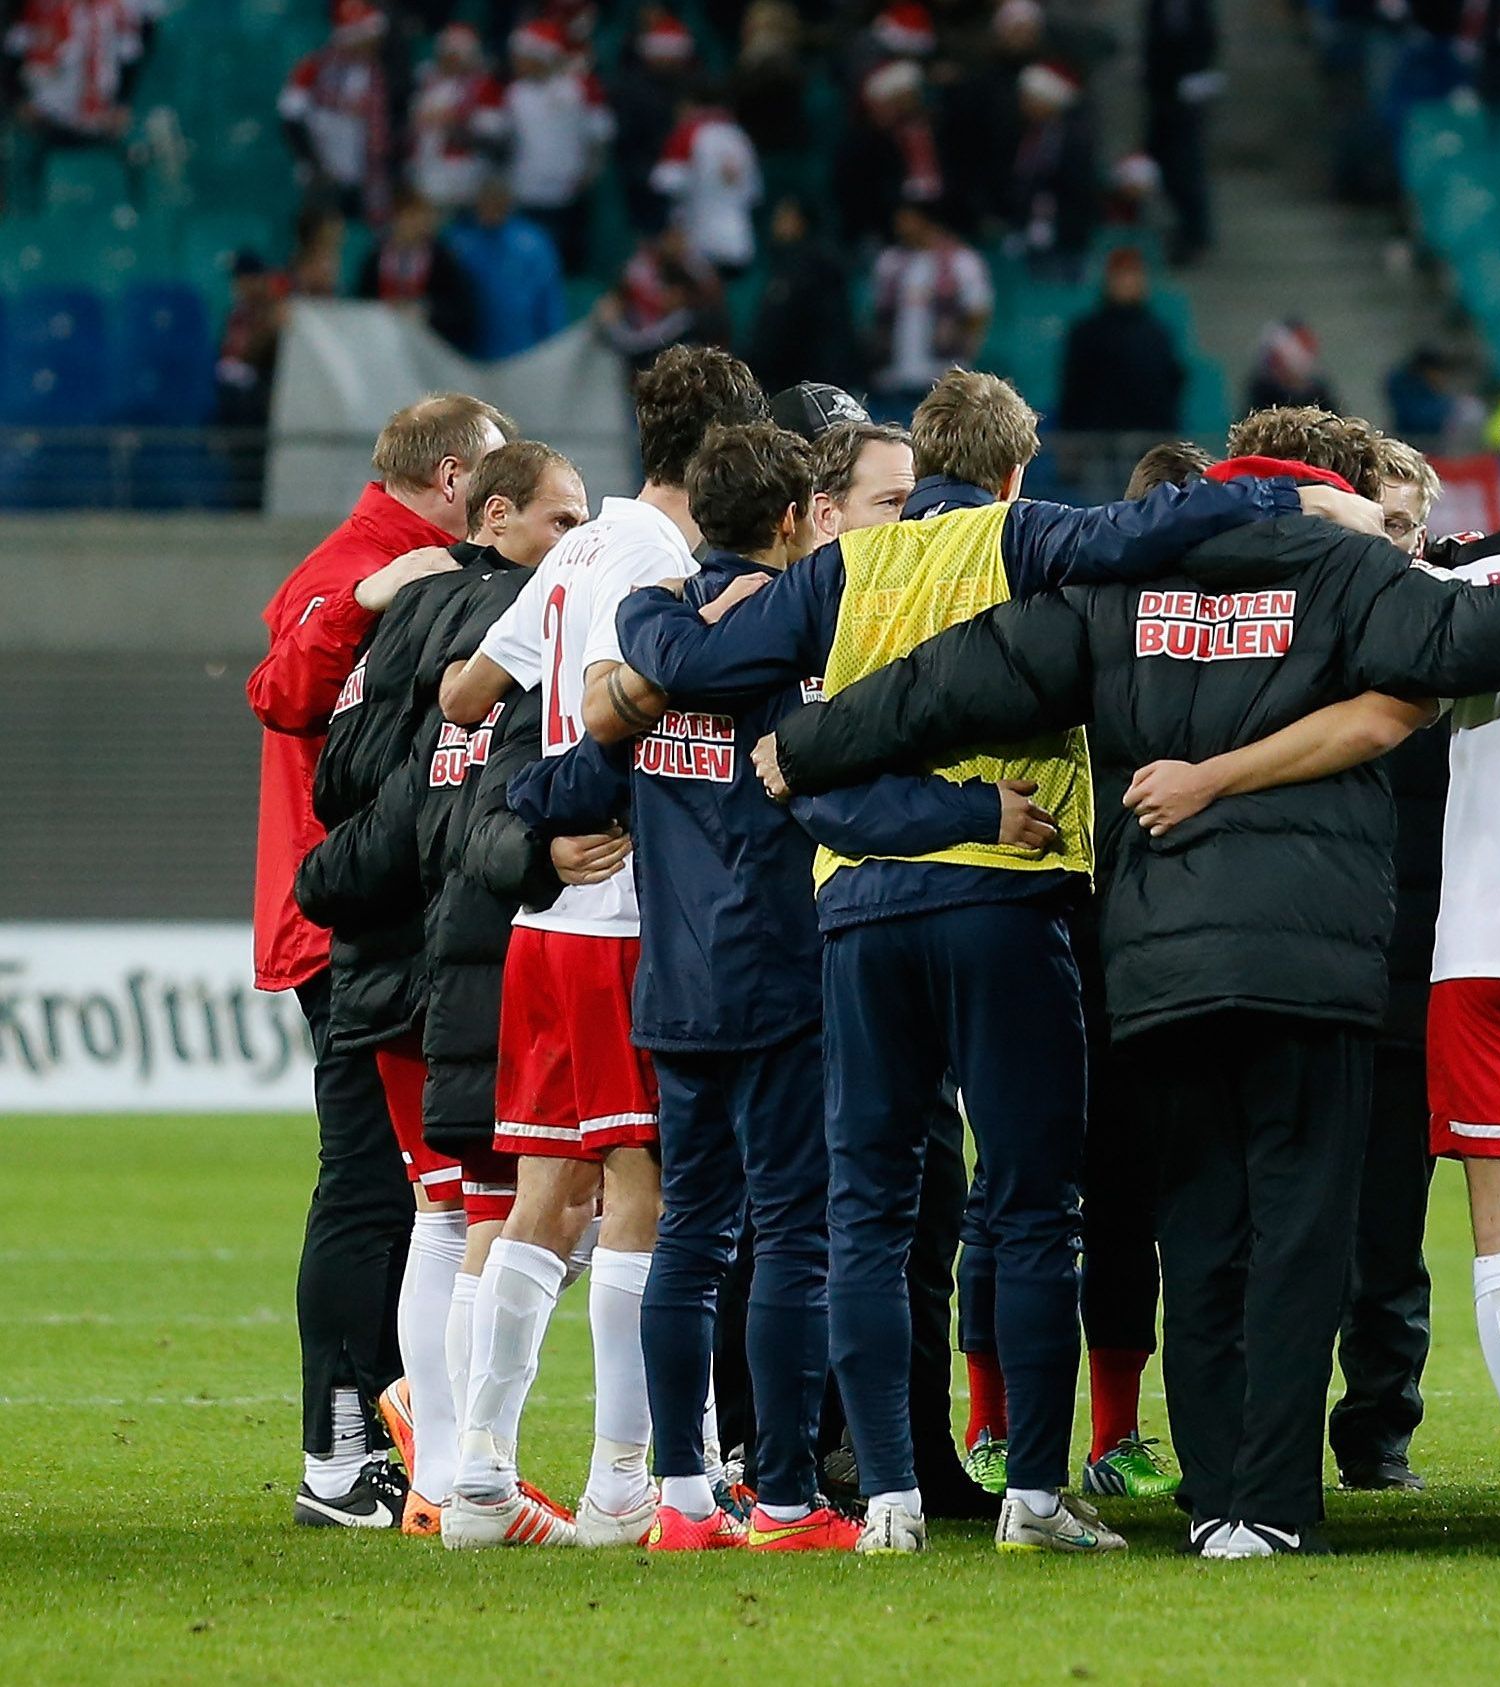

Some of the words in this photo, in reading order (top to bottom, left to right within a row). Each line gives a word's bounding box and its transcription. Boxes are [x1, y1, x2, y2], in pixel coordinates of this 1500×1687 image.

[1139, 592, 1197, 619] DIE
[1197, 591, 1296, 622] ROTEN
[1137, 620, 1293, 661] BULLEN
[634, 737, 734, 782] BULLEN
